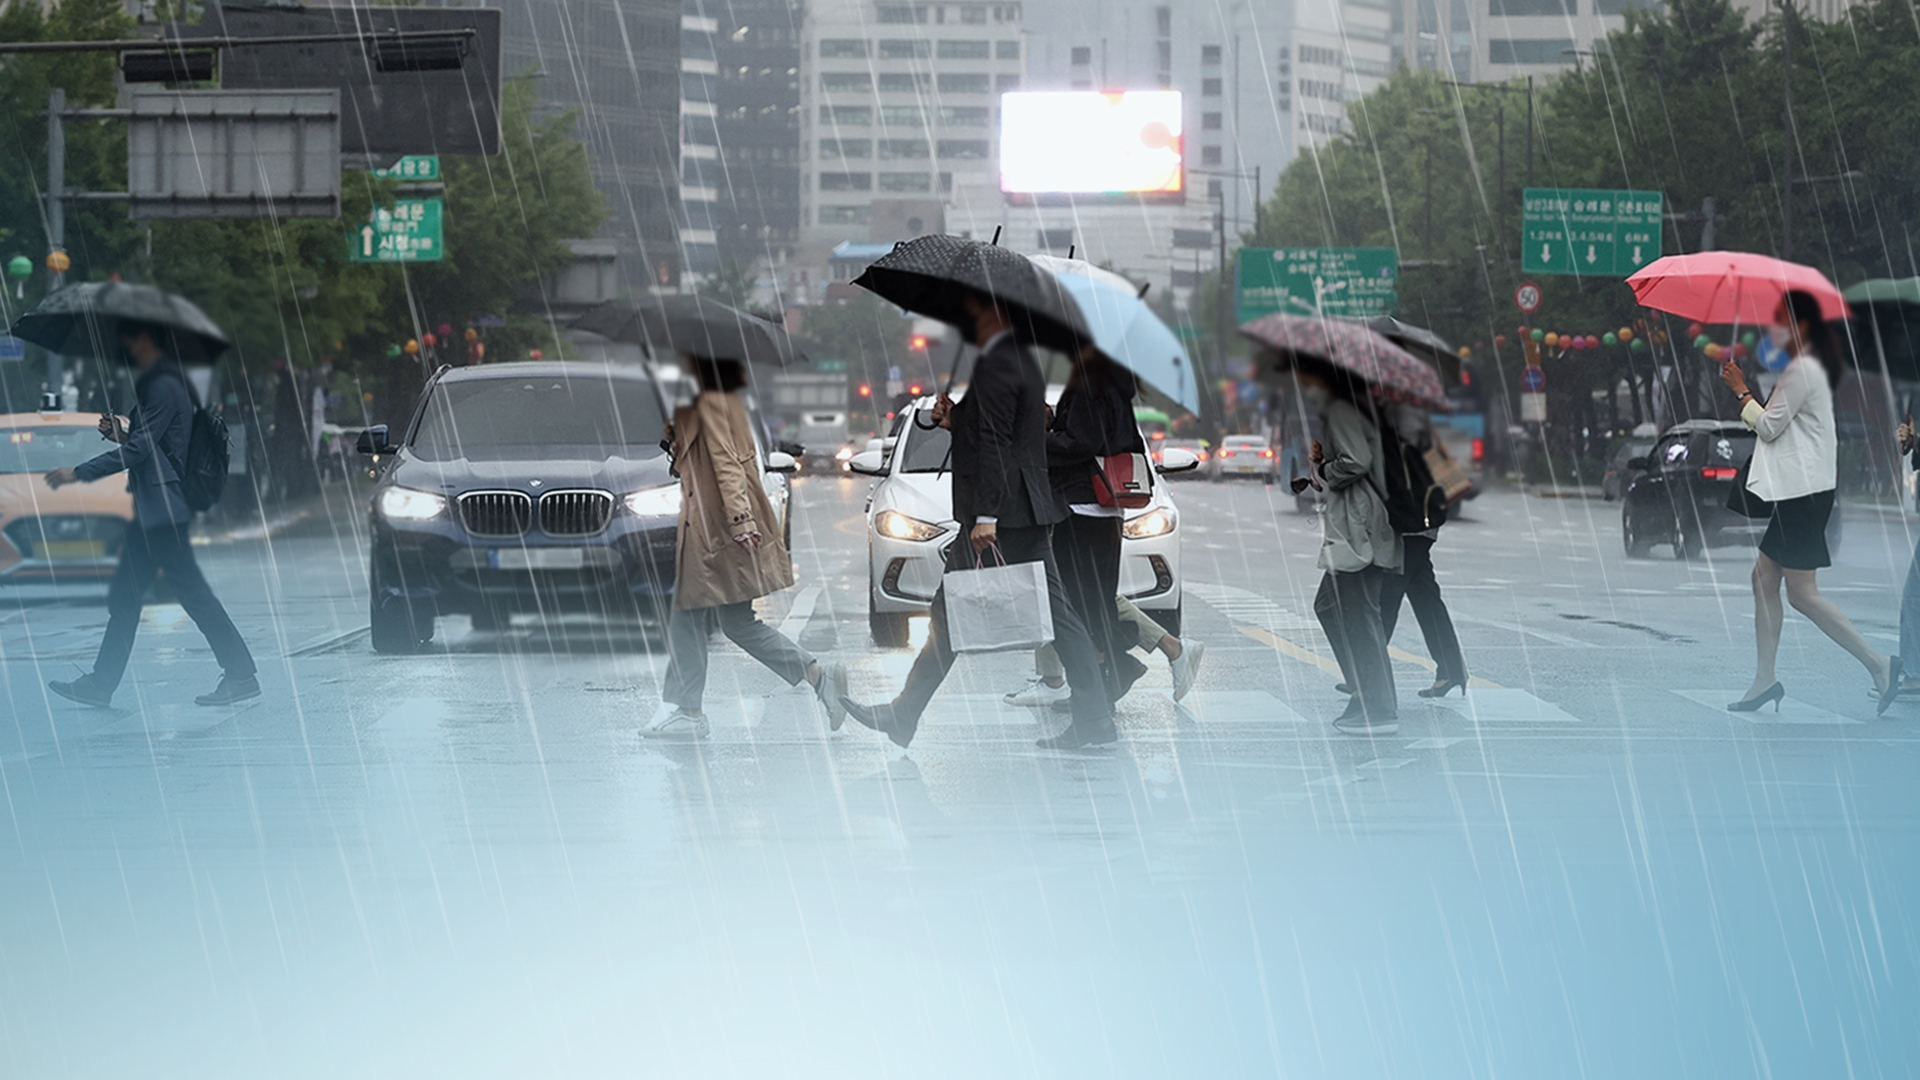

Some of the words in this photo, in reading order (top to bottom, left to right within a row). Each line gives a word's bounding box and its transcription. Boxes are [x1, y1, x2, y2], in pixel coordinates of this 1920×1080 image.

[1573, 199, 1611, 213] 숭례문
[378, 234, 409, 250] 시청
[1521, 289, 1537, 303] 50
